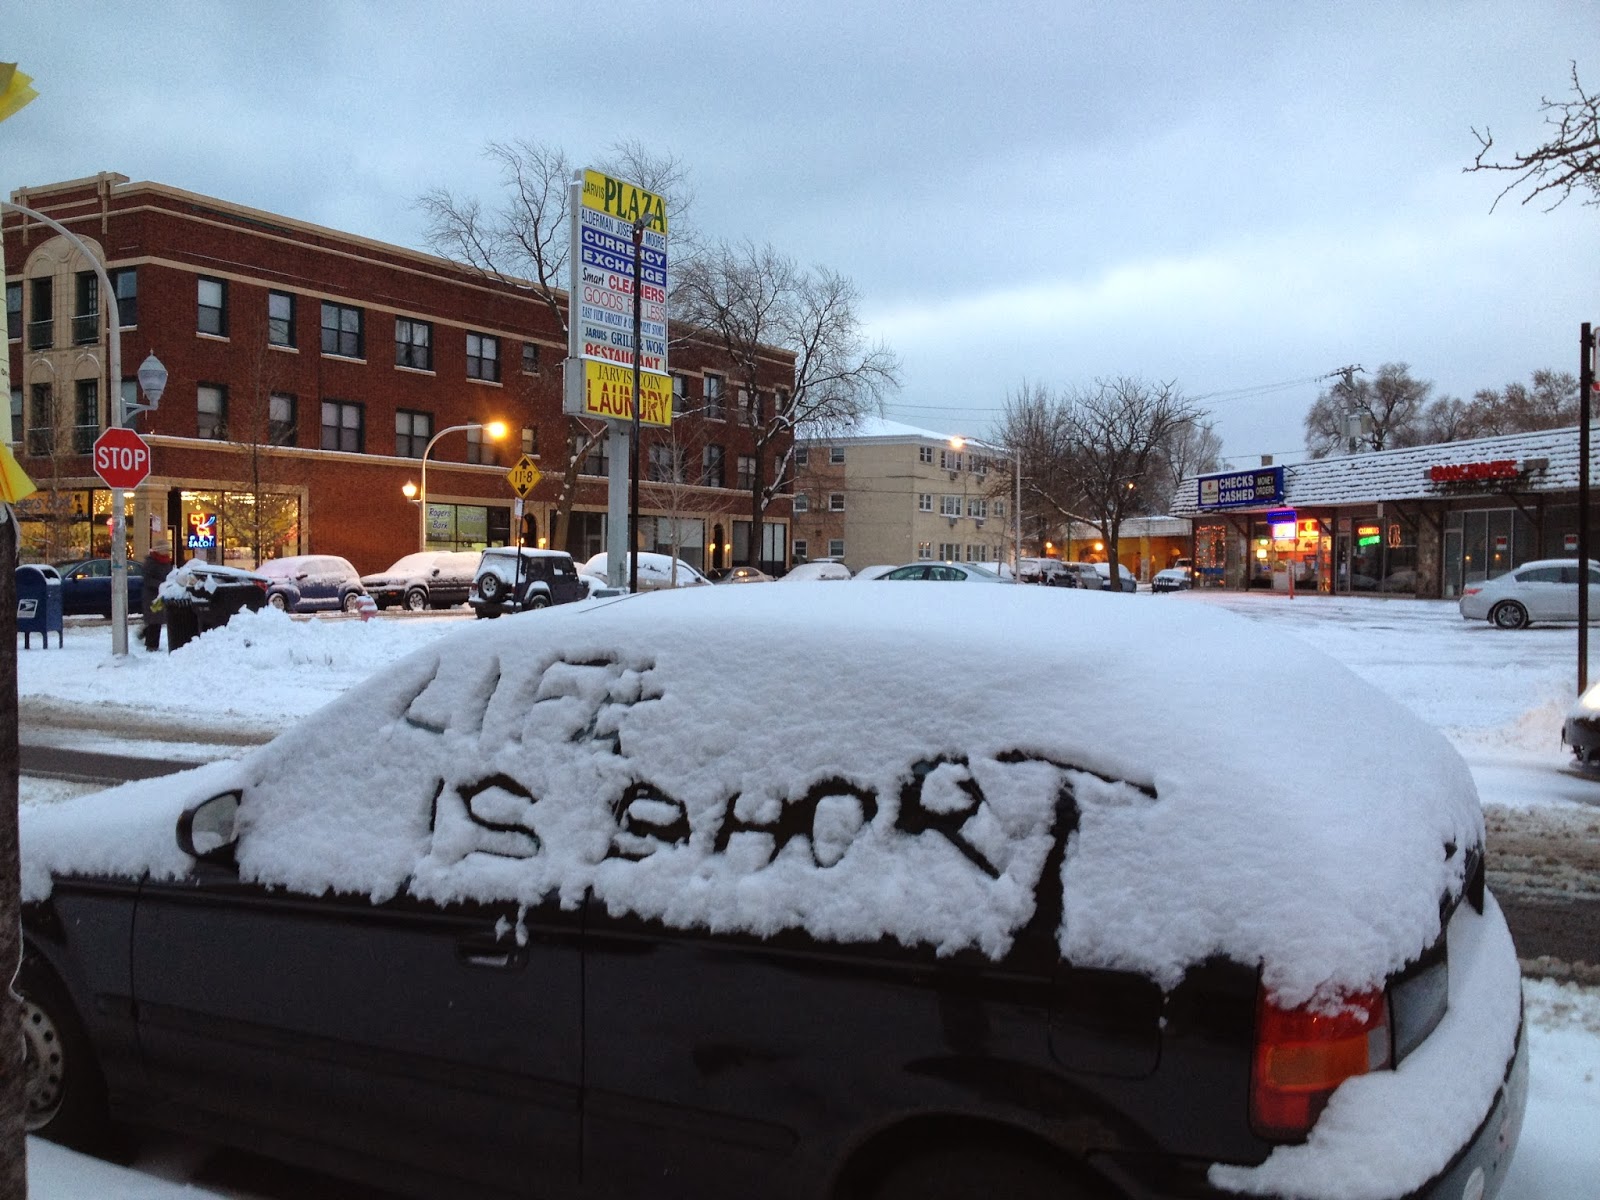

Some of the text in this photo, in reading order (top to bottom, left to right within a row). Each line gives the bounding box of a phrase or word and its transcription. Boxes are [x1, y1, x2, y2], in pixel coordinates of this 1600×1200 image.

[583, 177, 665, 232] JARVIS PLAZA
[581, 209, 614, 233] ALDERMAN
[645, 232, 665, 250] MOORE
[583, 267, 604, 286] Smart
[584, 286, 623, 310] GOODS
[646, 304, 665, 322] LESS
[604, 312, 623, 326] GROCERY
[611, 332, 635, 348] GRILL
[646, 340, 665, 356] WOK
[597, 365, 632, 384] JARVIS
[587, 379, 669, 423] LAUNDRY
[98, 446, 146, 471] STOP
[1219, 475, 1254, 490] CHECKS
[1255, 485, 1275, 496] ORDERS
[1256, 476, 1274, 486] MONEY
[1219, 488, 1255, 503] CASHED
[429, 507, 451, 519] Rogers
[427, 750, 1158, 955] IS SHORT
